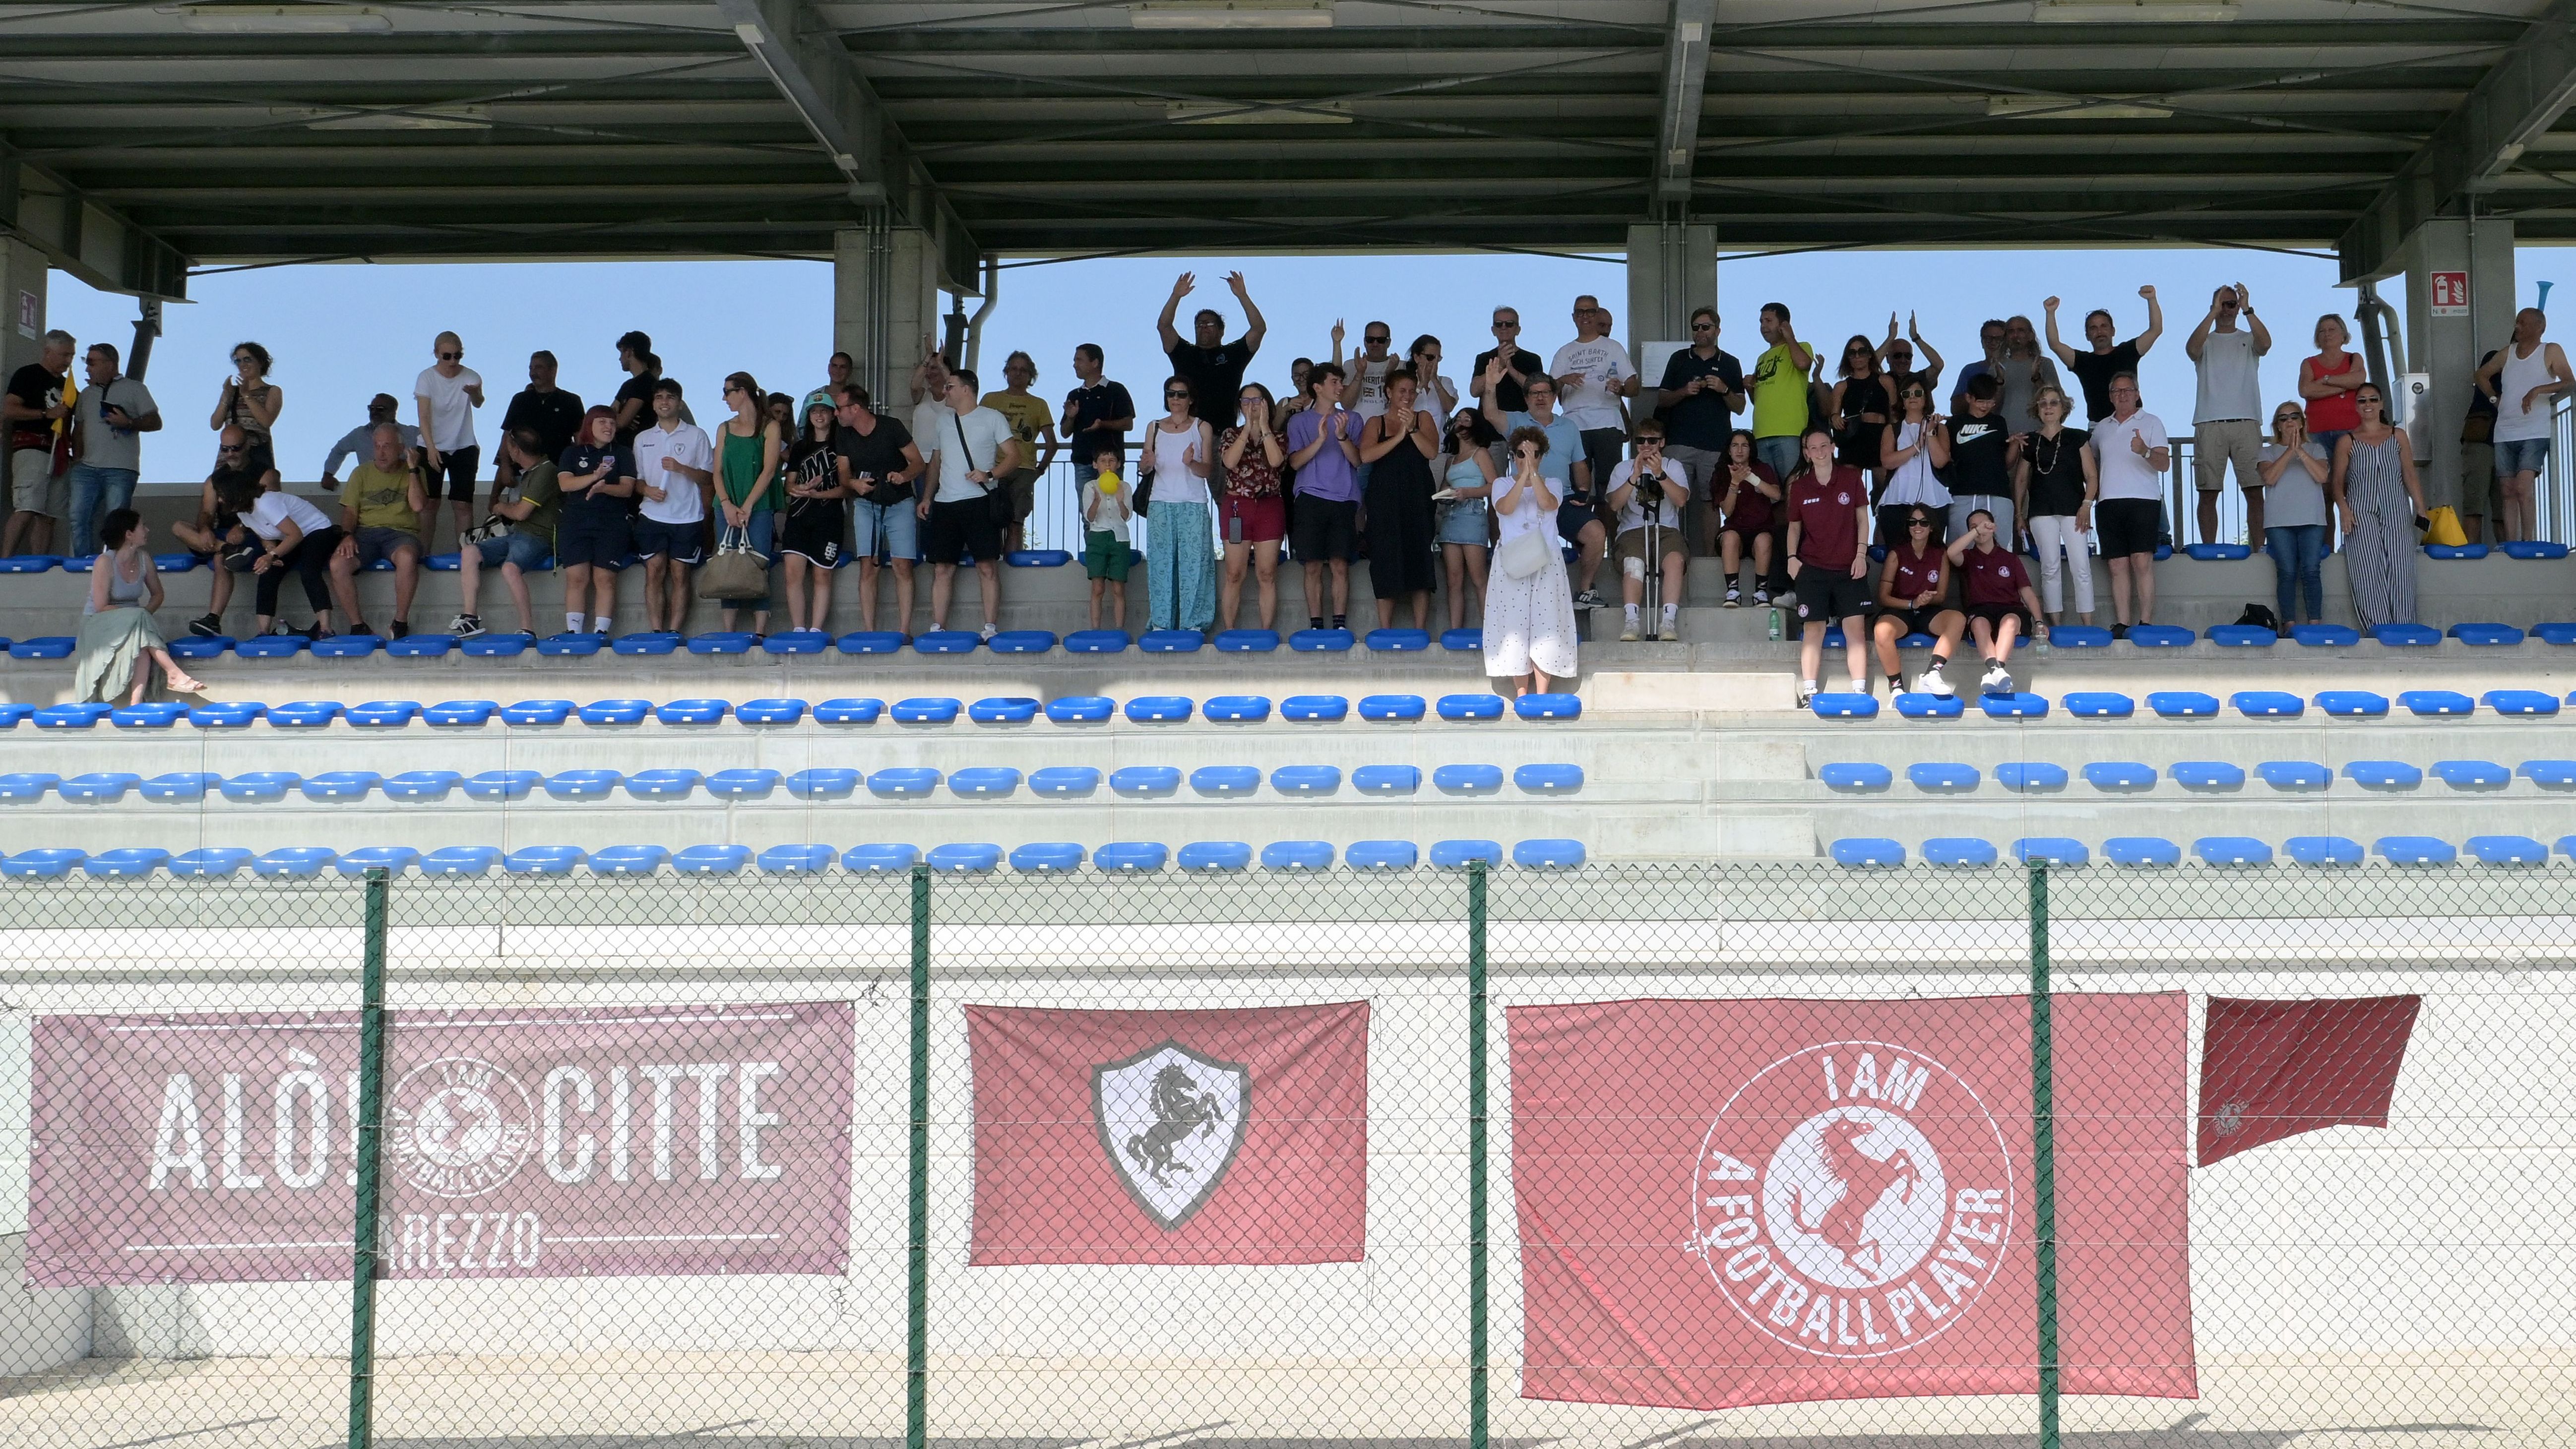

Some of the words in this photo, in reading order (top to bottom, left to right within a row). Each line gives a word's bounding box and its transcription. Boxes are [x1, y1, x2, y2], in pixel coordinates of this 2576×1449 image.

[1569, 349, 1586, 362] SAINT
[1588, 348, 1609, 358] BARTH
[1960, 424, 1988, 434] NIKE
[1822, 1055, 1838, 1101] I
[1848, 1052, 1931, 1112] AM
[542, 1062, 782, 1184] CITTE
[1706, 1149, 1757, 1181] A
[1705, 1193, 1888, 1346] FOOTBALL
[1884, 1187, 2005, 1336] PLAYER
